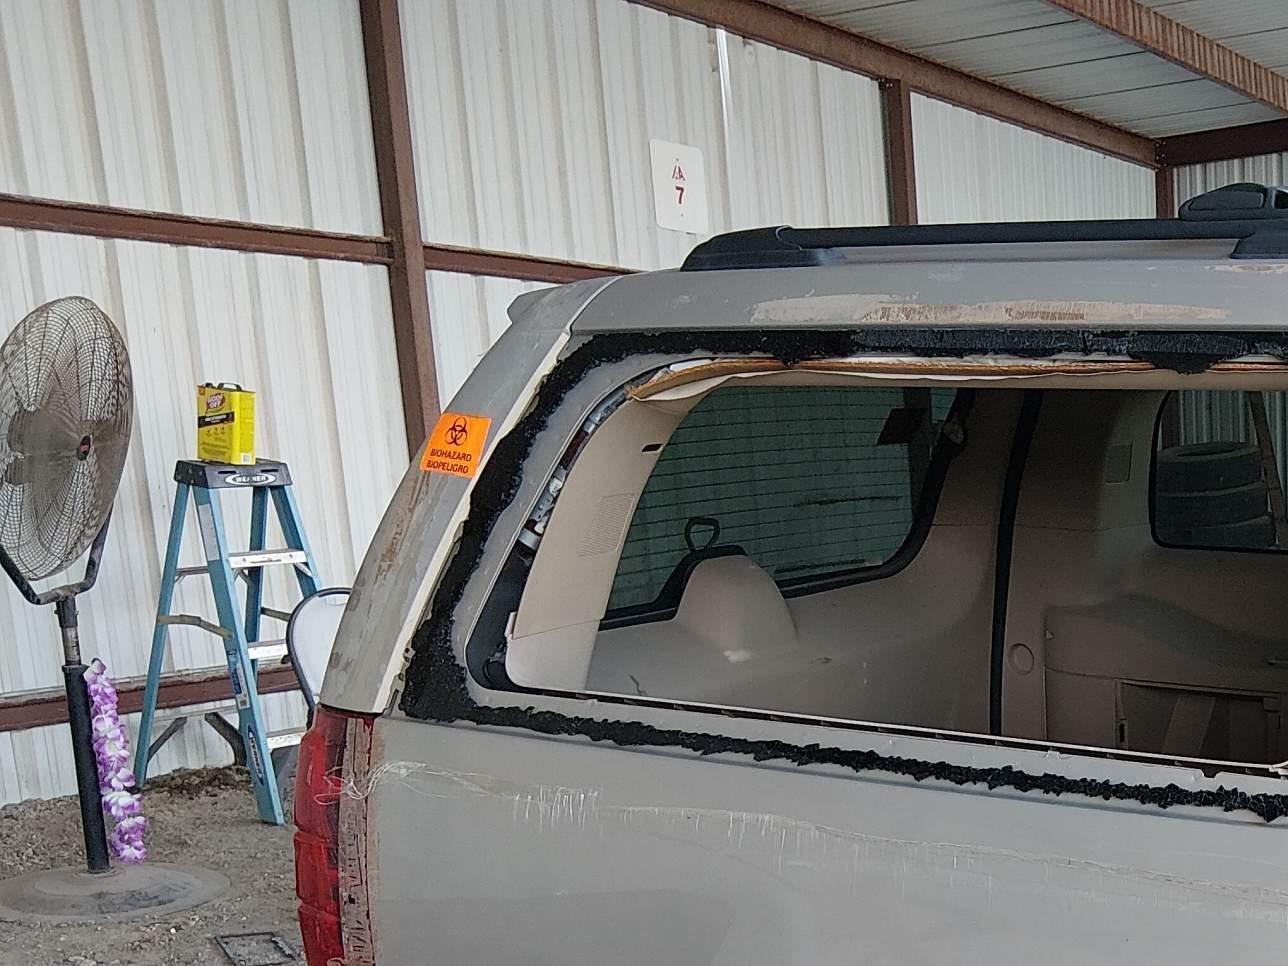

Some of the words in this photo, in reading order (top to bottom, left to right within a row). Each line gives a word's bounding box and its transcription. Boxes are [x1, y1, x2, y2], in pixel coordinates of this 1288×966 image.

[675, 186, 684, 204] 7
[430, 448, 472, 462] BIOHAZARD
[426, 460, 469, 474] BIOPELIGRO
